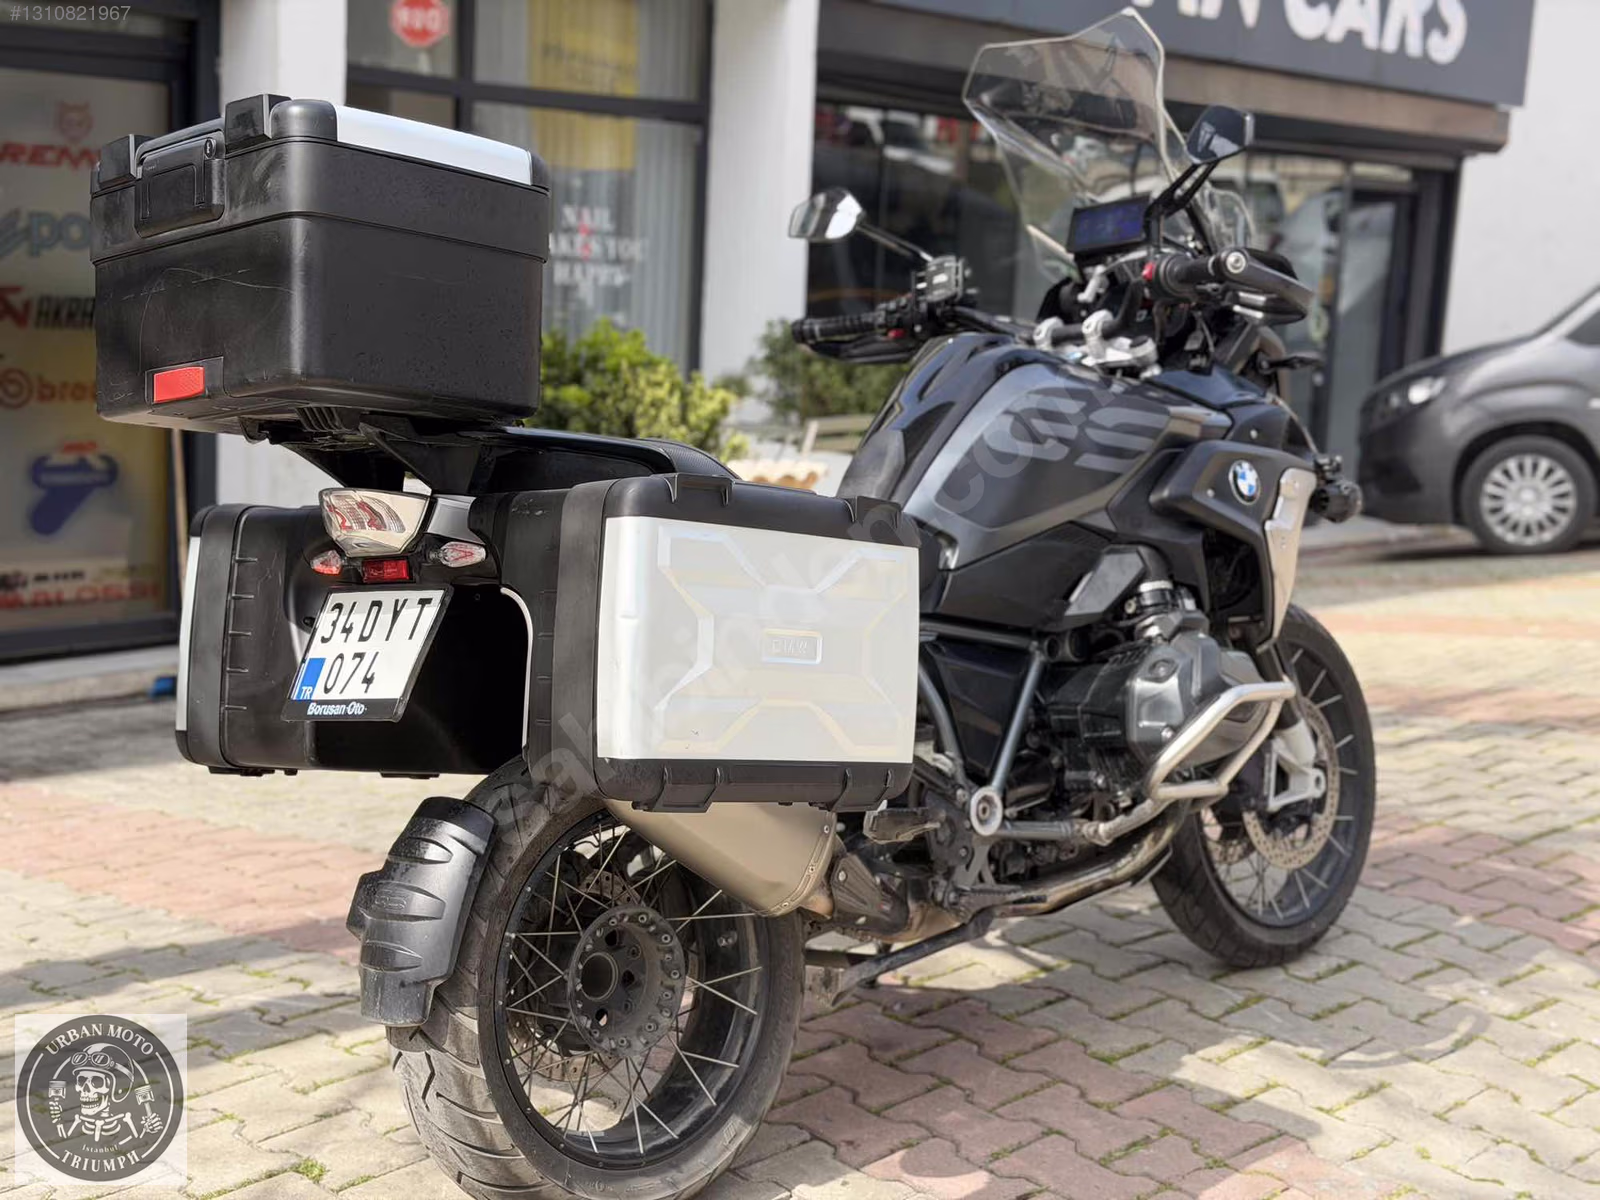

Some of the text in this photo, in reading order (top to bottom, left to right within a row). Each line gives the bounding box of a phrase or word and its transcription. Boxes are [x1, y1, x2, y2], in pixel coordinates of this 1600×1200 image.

[323, 651, 379, 694] 074
[300, 686, 313, 700] TR
[306, 701, 366, 716] Borusan Oto
